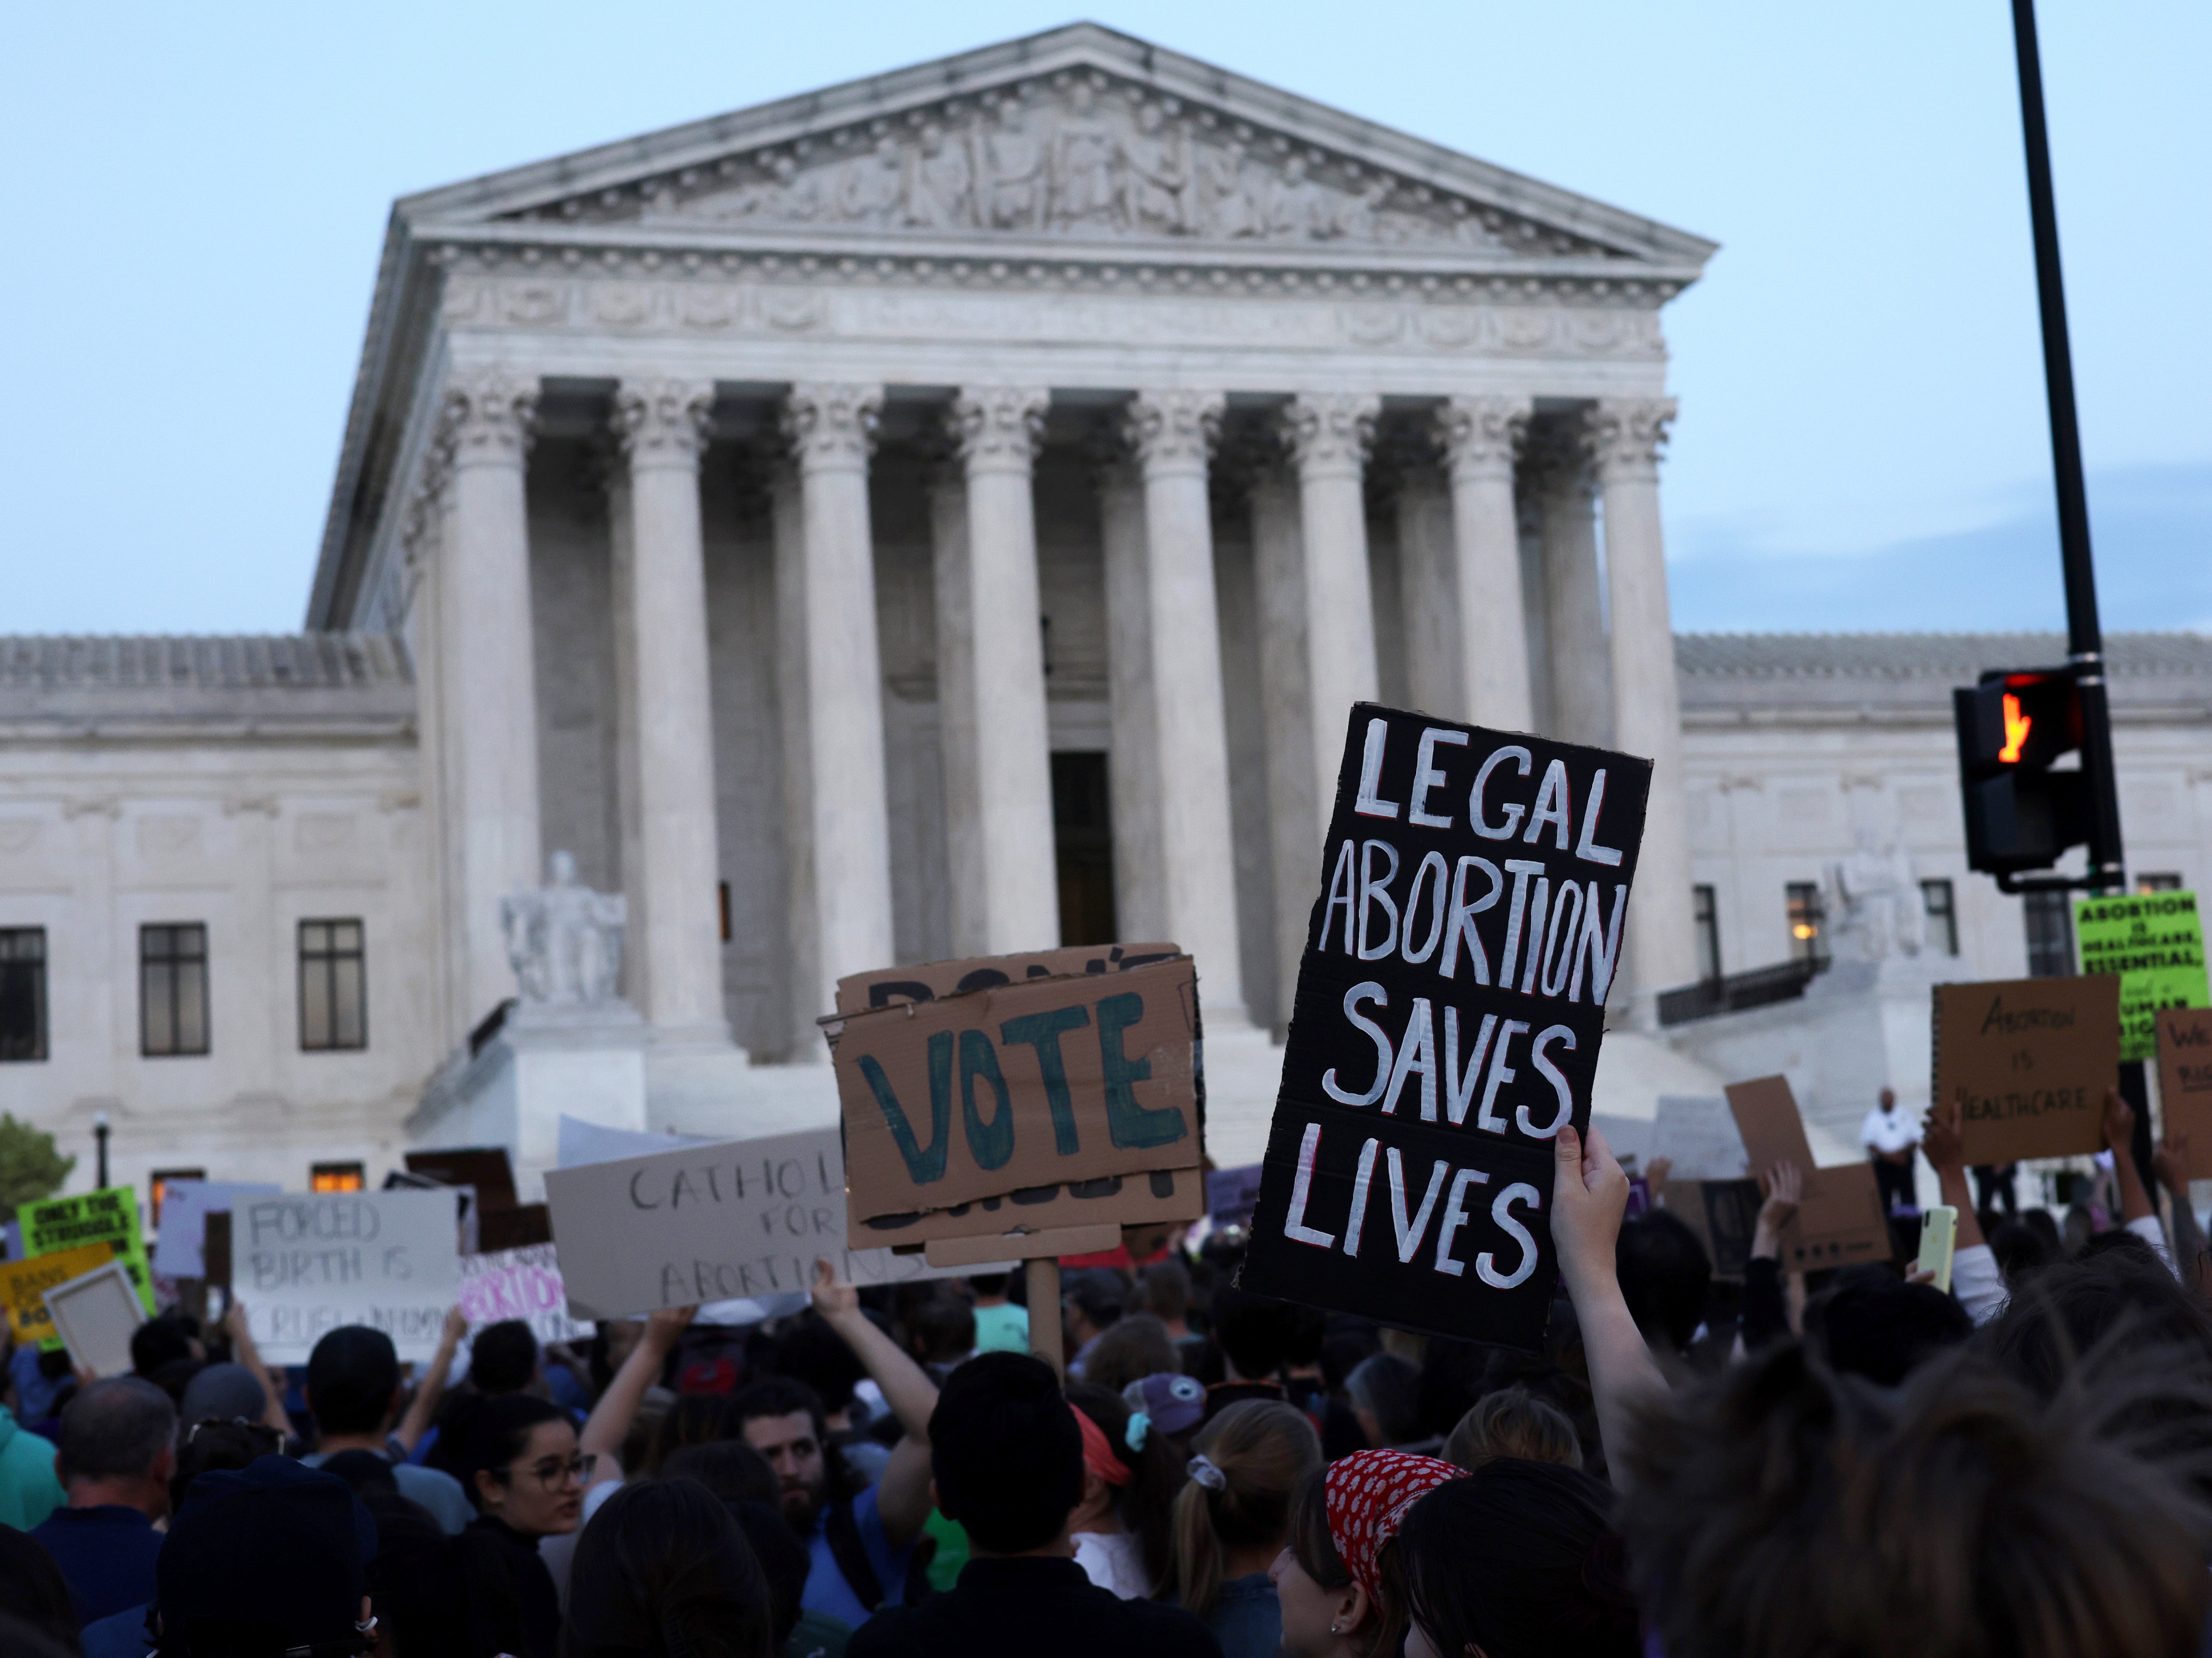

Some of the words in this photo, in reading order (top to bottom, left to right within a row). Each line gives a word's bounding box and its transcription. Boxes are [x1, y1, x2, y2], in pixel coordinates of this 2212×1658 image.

[1354, 718, 1623, 867] LEGAL
[1317, 839, 1627, 1006] ABORTION
[2080, 897, 2196, 923] ABORTION
[2121, 996, 2187, 1016] UMAN
[856, 992, 1189, 1185] VOTE
[1322, 981, 1577, 1140] SAVES
[628, 1149, 844, 1211] CATHOL
[1284, 1123, 1540, 1290] LIVES
[249, 1199, 381, 1246] FORCED
[759, 1204, 839, 1237] FOR
[250, 1246, 362, 1293] BIRTH
[382, 1245, 414, 1282] IS
